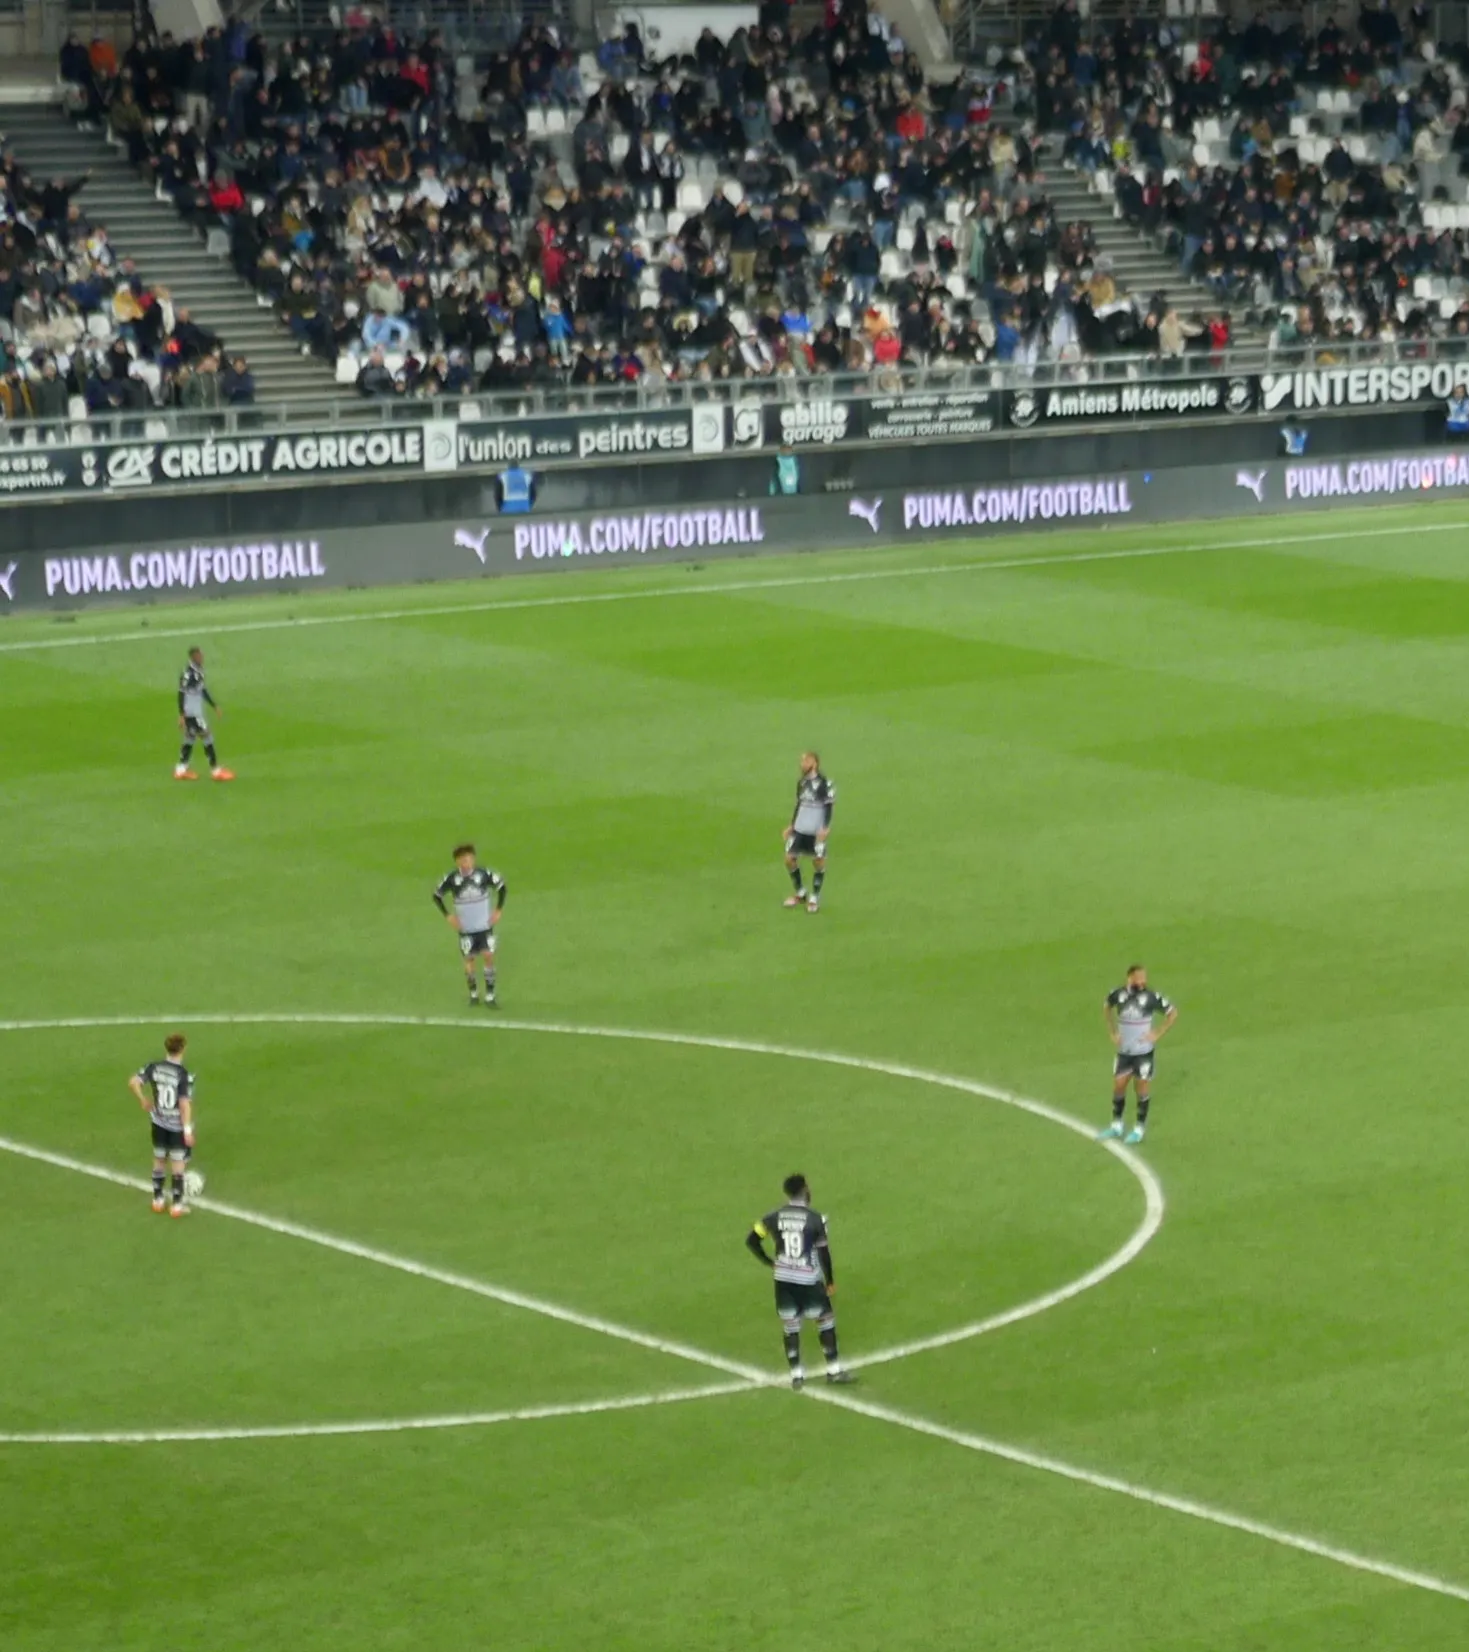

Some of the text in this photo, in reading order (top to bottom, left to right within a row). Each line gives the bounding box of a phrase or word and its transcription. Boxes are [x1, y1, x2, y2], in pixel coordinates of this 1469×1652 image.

[1046, 390, 1118, 416] Amiens
[1121, 384, 1218, 414] Métropole
[161, 431, 265, 478] CRÉDIT
[272, 432, 421, 472] AGRICOLE
[458, 432, 531, 463] l'union
[579, 421, 689, 460] peintres
[903, 481, 1132, 529] PUMA.COM/FOOTBALL
[513, 508, 764, 560] PUMA.COM/FOOTBALL
[45, 541, 325, 597] PUMA.COM/FOOTBALL
[782, 1230, 803, 1258] 19
